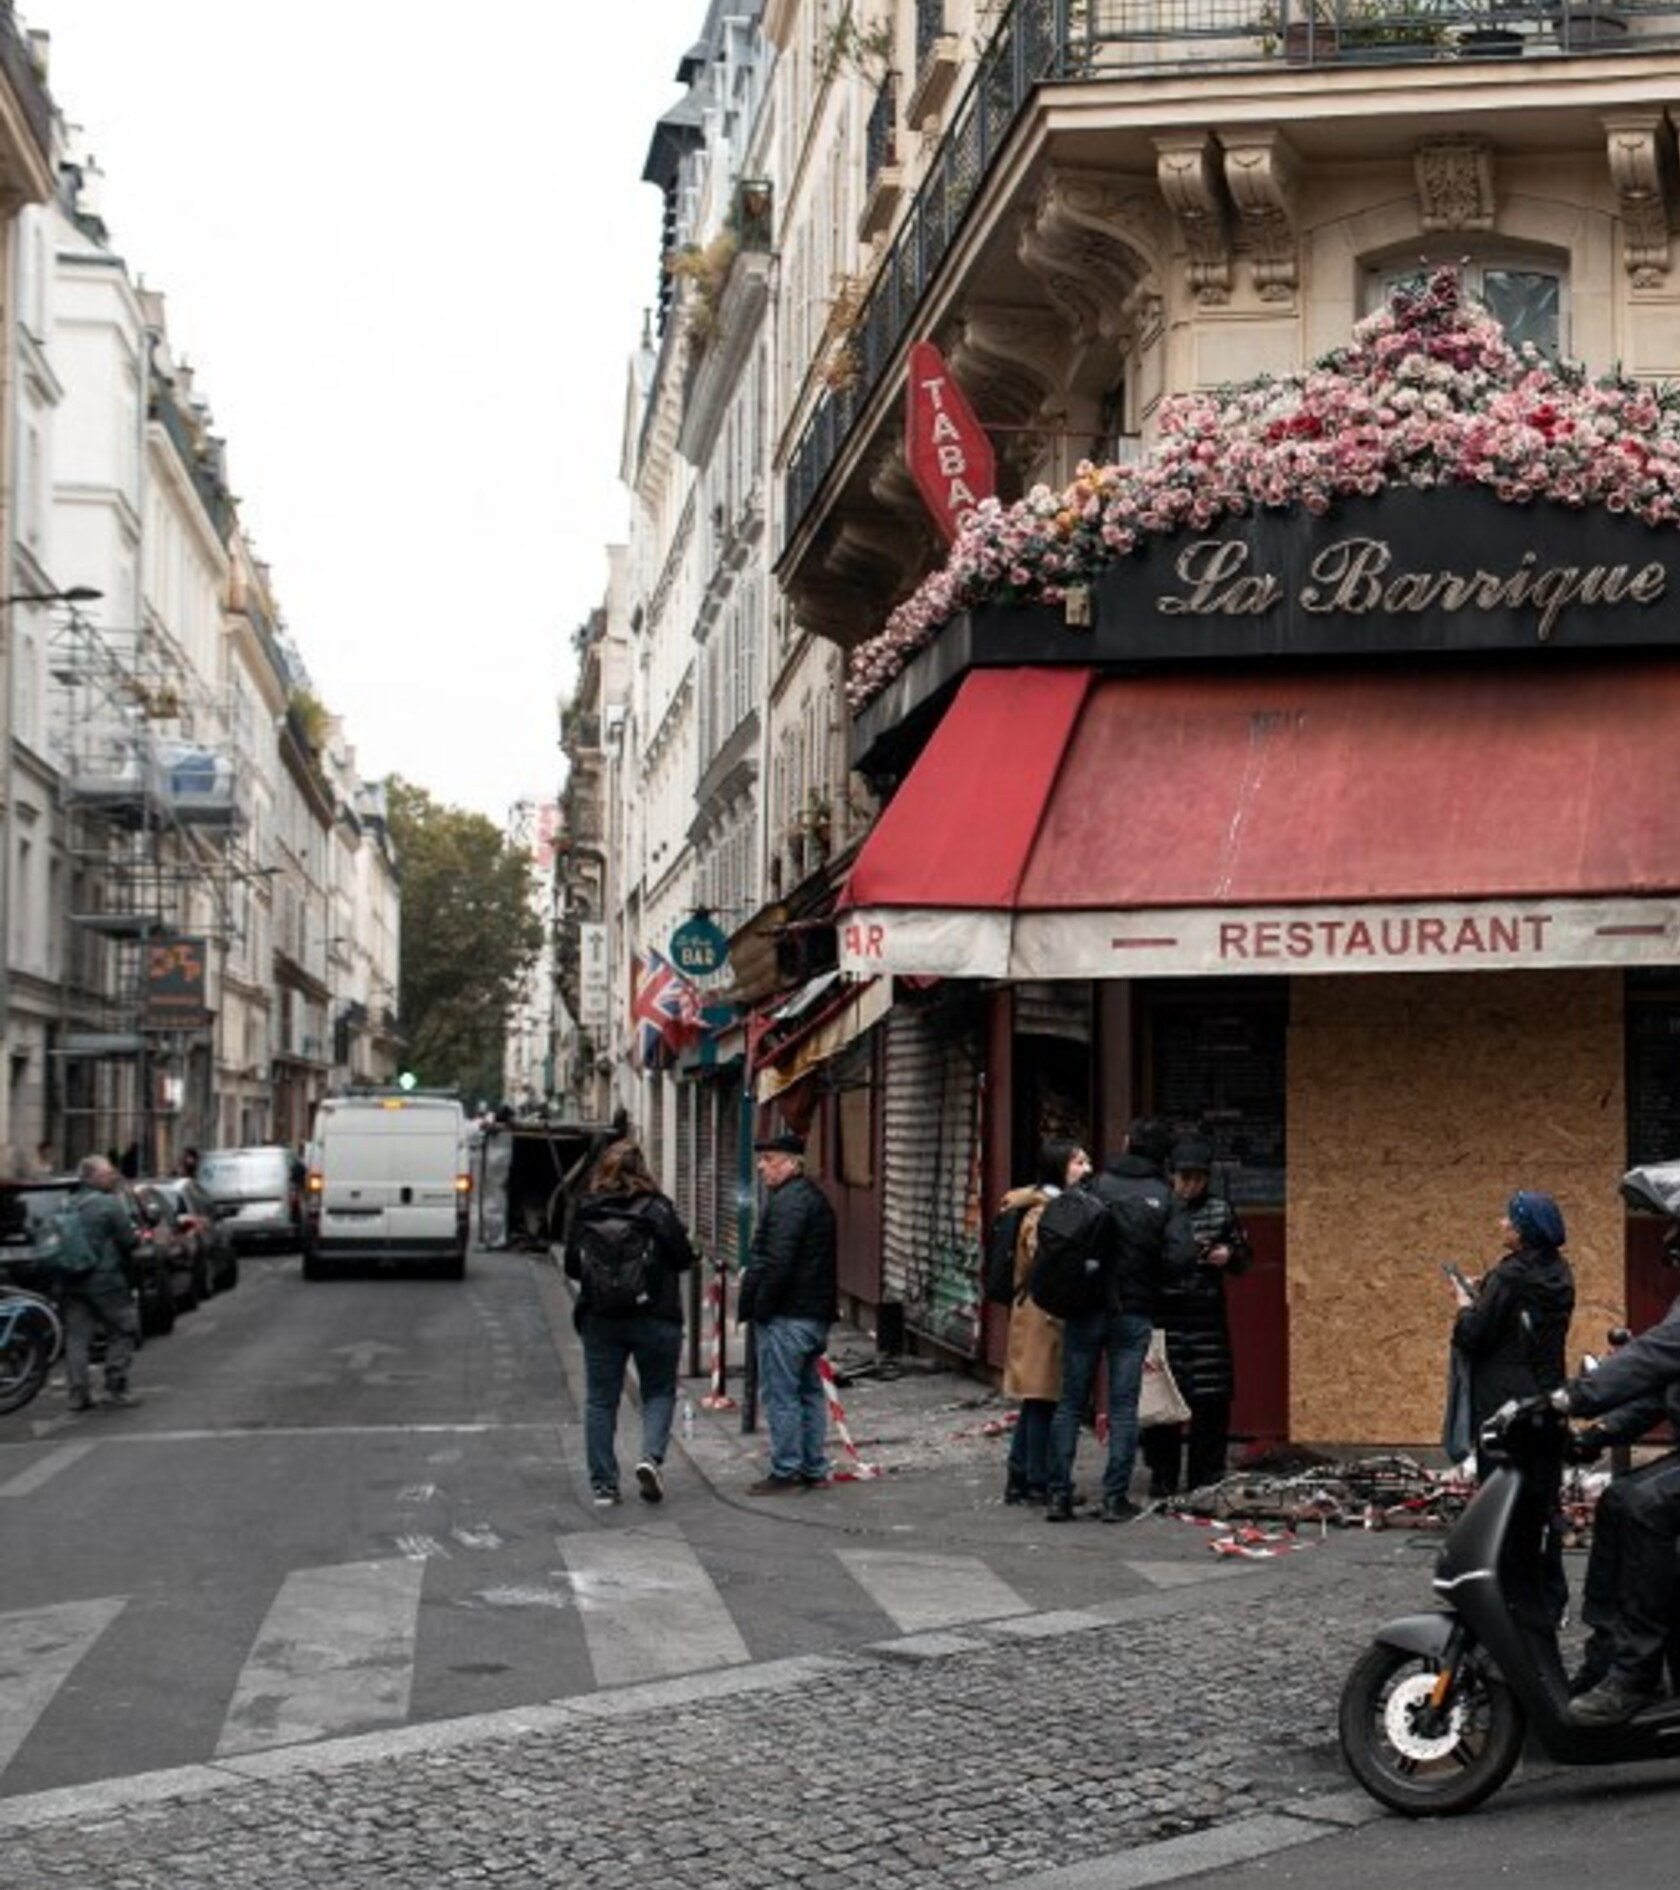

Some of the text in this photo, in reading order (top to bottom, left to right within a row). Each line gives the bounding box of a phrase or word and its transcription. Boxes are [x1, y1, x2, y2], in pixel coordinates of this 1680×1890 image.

[1157, 536, 1666, 640] La Barrique
[682, 947, 716, 966] BAR
[1218, 914, 1552, 959] RESTAURANT
